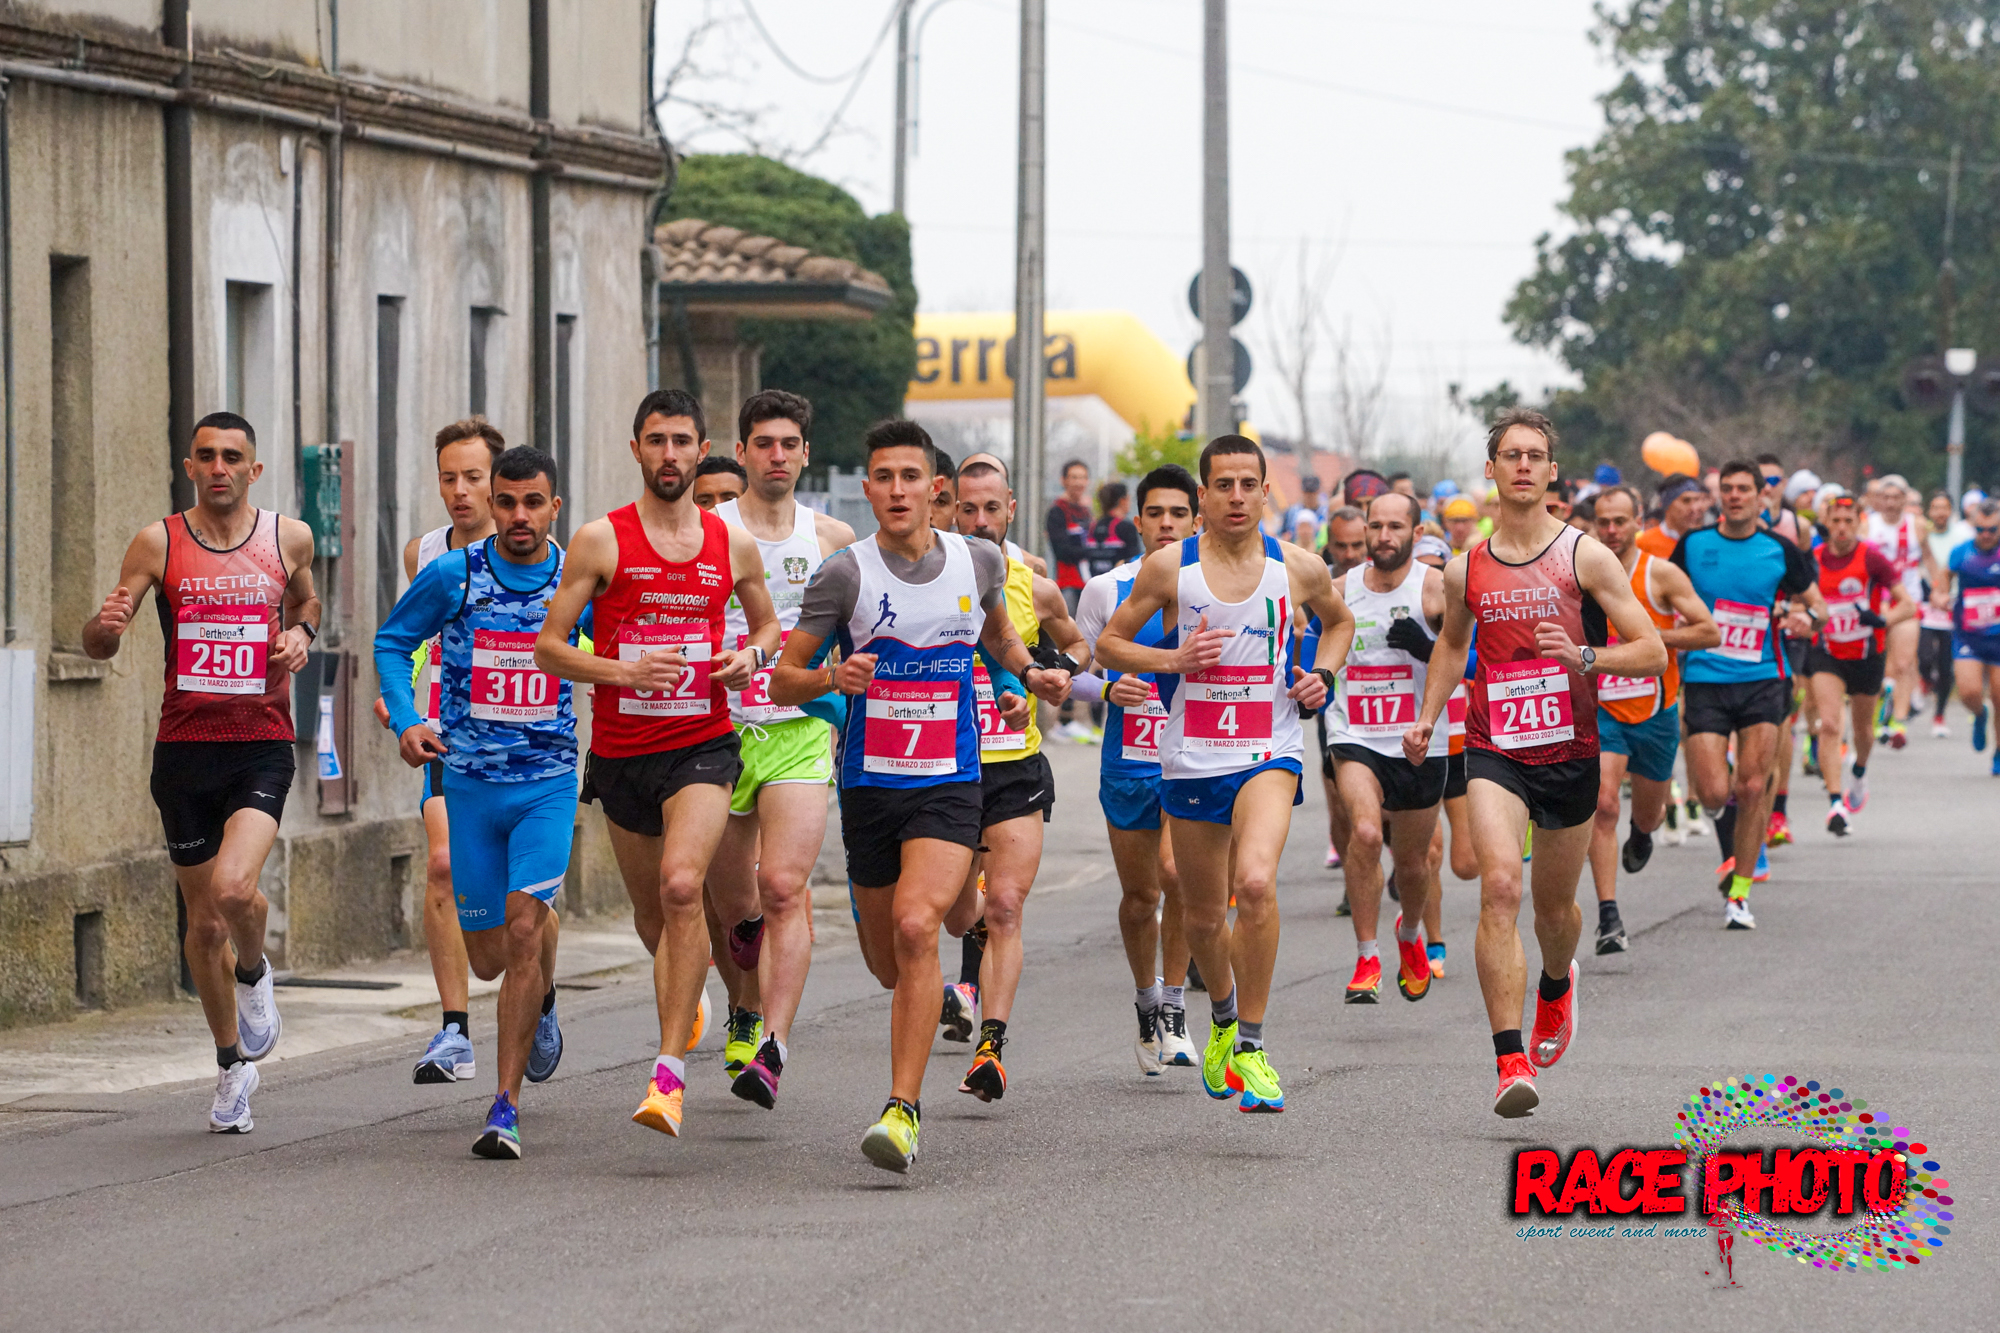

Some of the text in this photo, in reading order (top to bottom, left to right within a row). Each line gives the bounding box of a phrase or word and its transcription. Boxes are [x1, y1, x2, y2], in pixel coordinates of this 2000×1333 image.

[696, 562, 717, 571] Circolo
[698, 570, 722, 580] Minerva
[178, 574, 270, 592] ATLETICA
[667, 573, 686, 581] GORE
[701, 578, 719, 587] A.S.D.
[182, 588, 267, 605] SANTHIÀ
[1480, 586, 1560, 606] ATLETICA
[1482, 601, 1560, 624] SANTHIÀ
[200, 627, 236, 639] Derthona
[1720, 626, 1757, 649] 144
[191, 643, 254, 676] 250
[494, 655, 532, 667] Derthona
[486, 672, 547, 705] 310
[754, 672, 771, 703] 3
[1206, 689, 1242, 700] Derthona
[1505, 684, 1539, 697] Derthona
[888, 706, 927, 718] Derthona
[1360, 696, 1401, 723] 117
[1501, 696, 1561, 733] 246
[1217, 705, 1239, 736] 4
[902, 724, 922, 756] 7
[1520, 733, 1540, 741] MARZO
[1541, 730, 1554, 739] 2023
[460, 908, 487, 917] CITO
